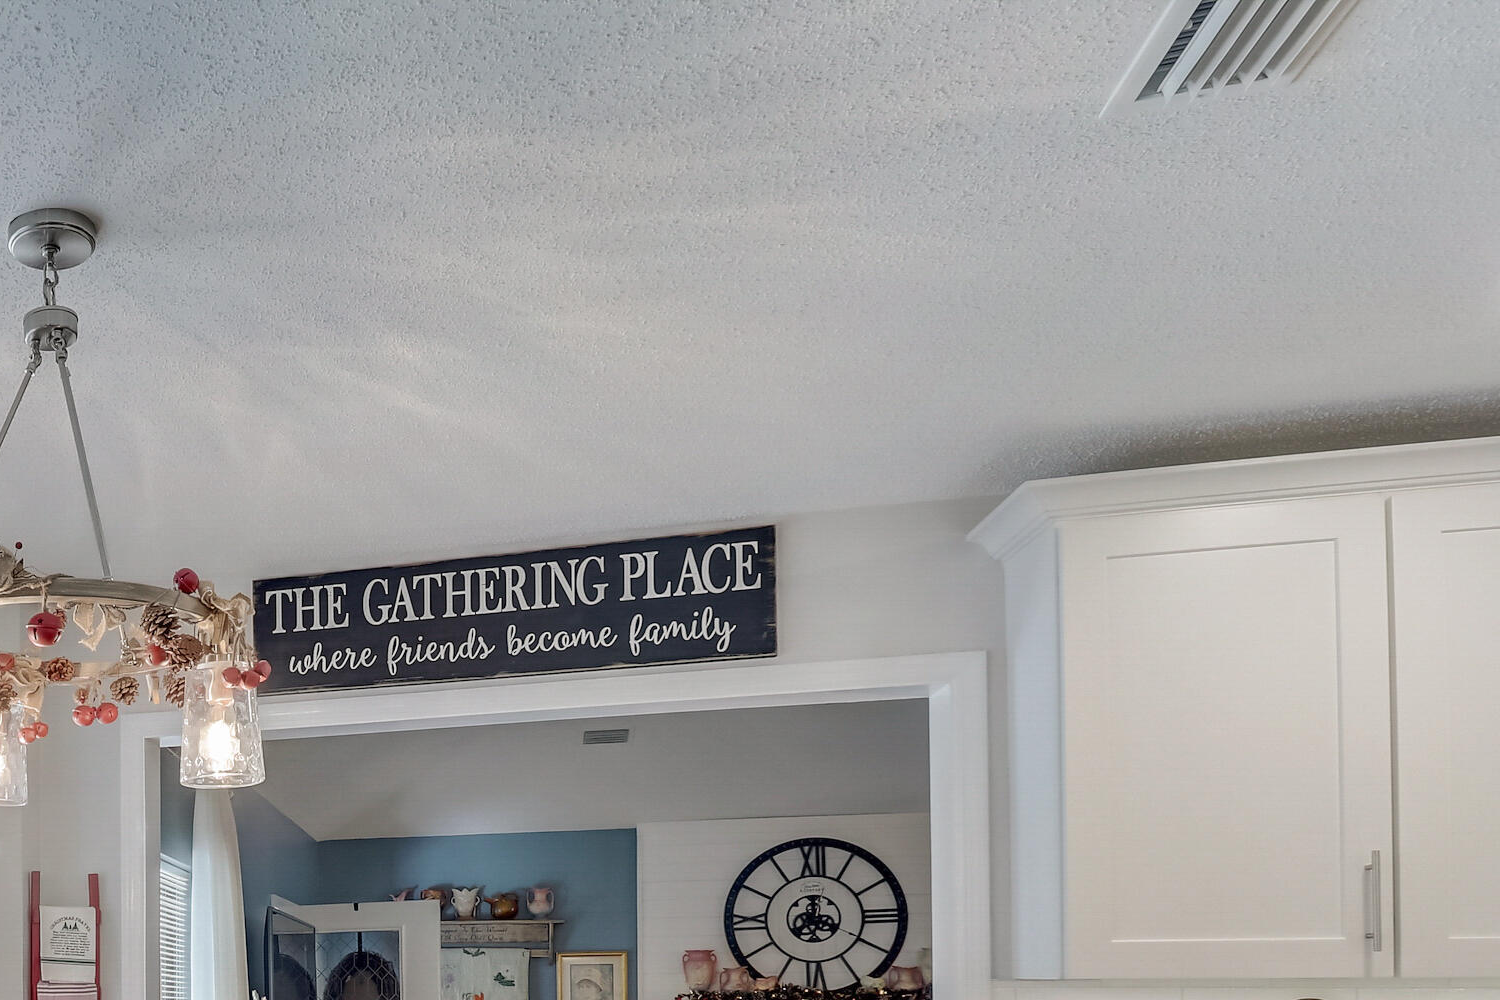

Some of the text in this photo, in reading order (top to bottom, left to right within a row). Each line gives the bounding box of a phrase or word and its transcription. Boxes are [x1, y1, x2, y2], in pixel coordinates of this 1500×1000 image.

[265, 540, 762, 634] THE GATHERING PLACE
[289, 606, 737, 676] where friends become family
